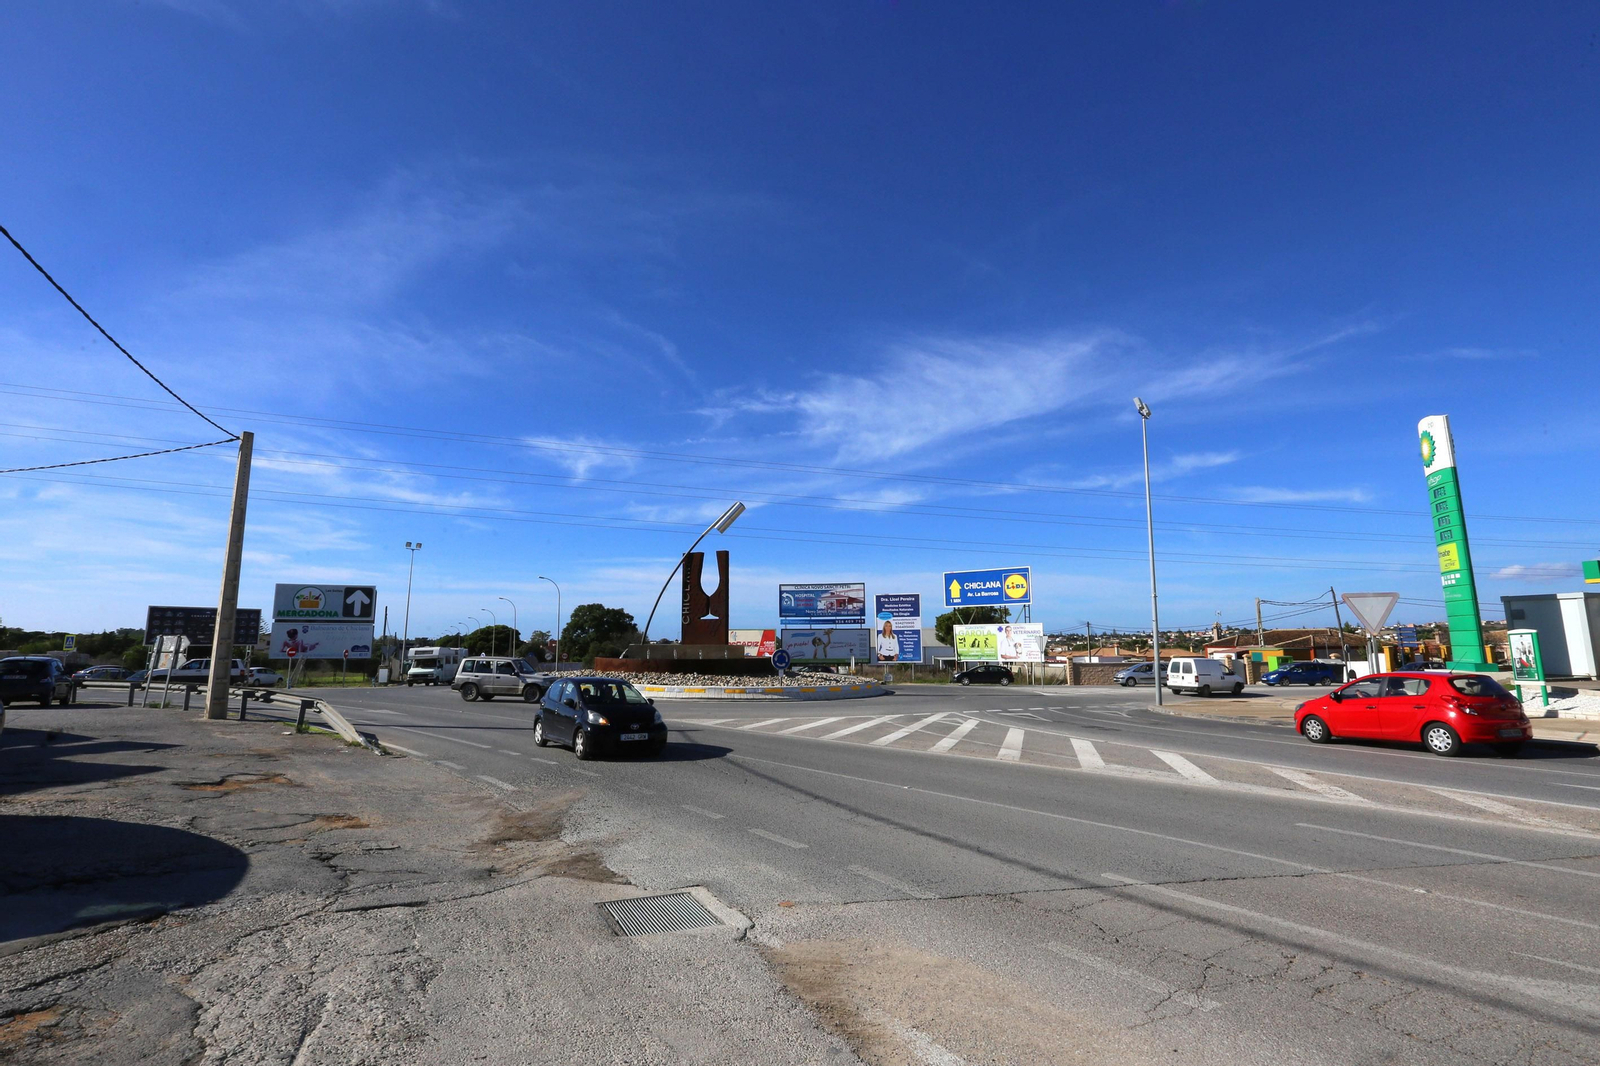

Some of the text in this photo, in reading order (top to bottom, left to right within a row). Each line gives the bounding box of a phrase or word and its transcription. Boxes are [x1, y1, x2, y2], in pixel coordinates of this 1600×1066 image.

[963, 580, 1002, 590] CHICLANA
[682, 566, 691, 625] CHICLA
[276, 609, 339, 618] MERCADONA
